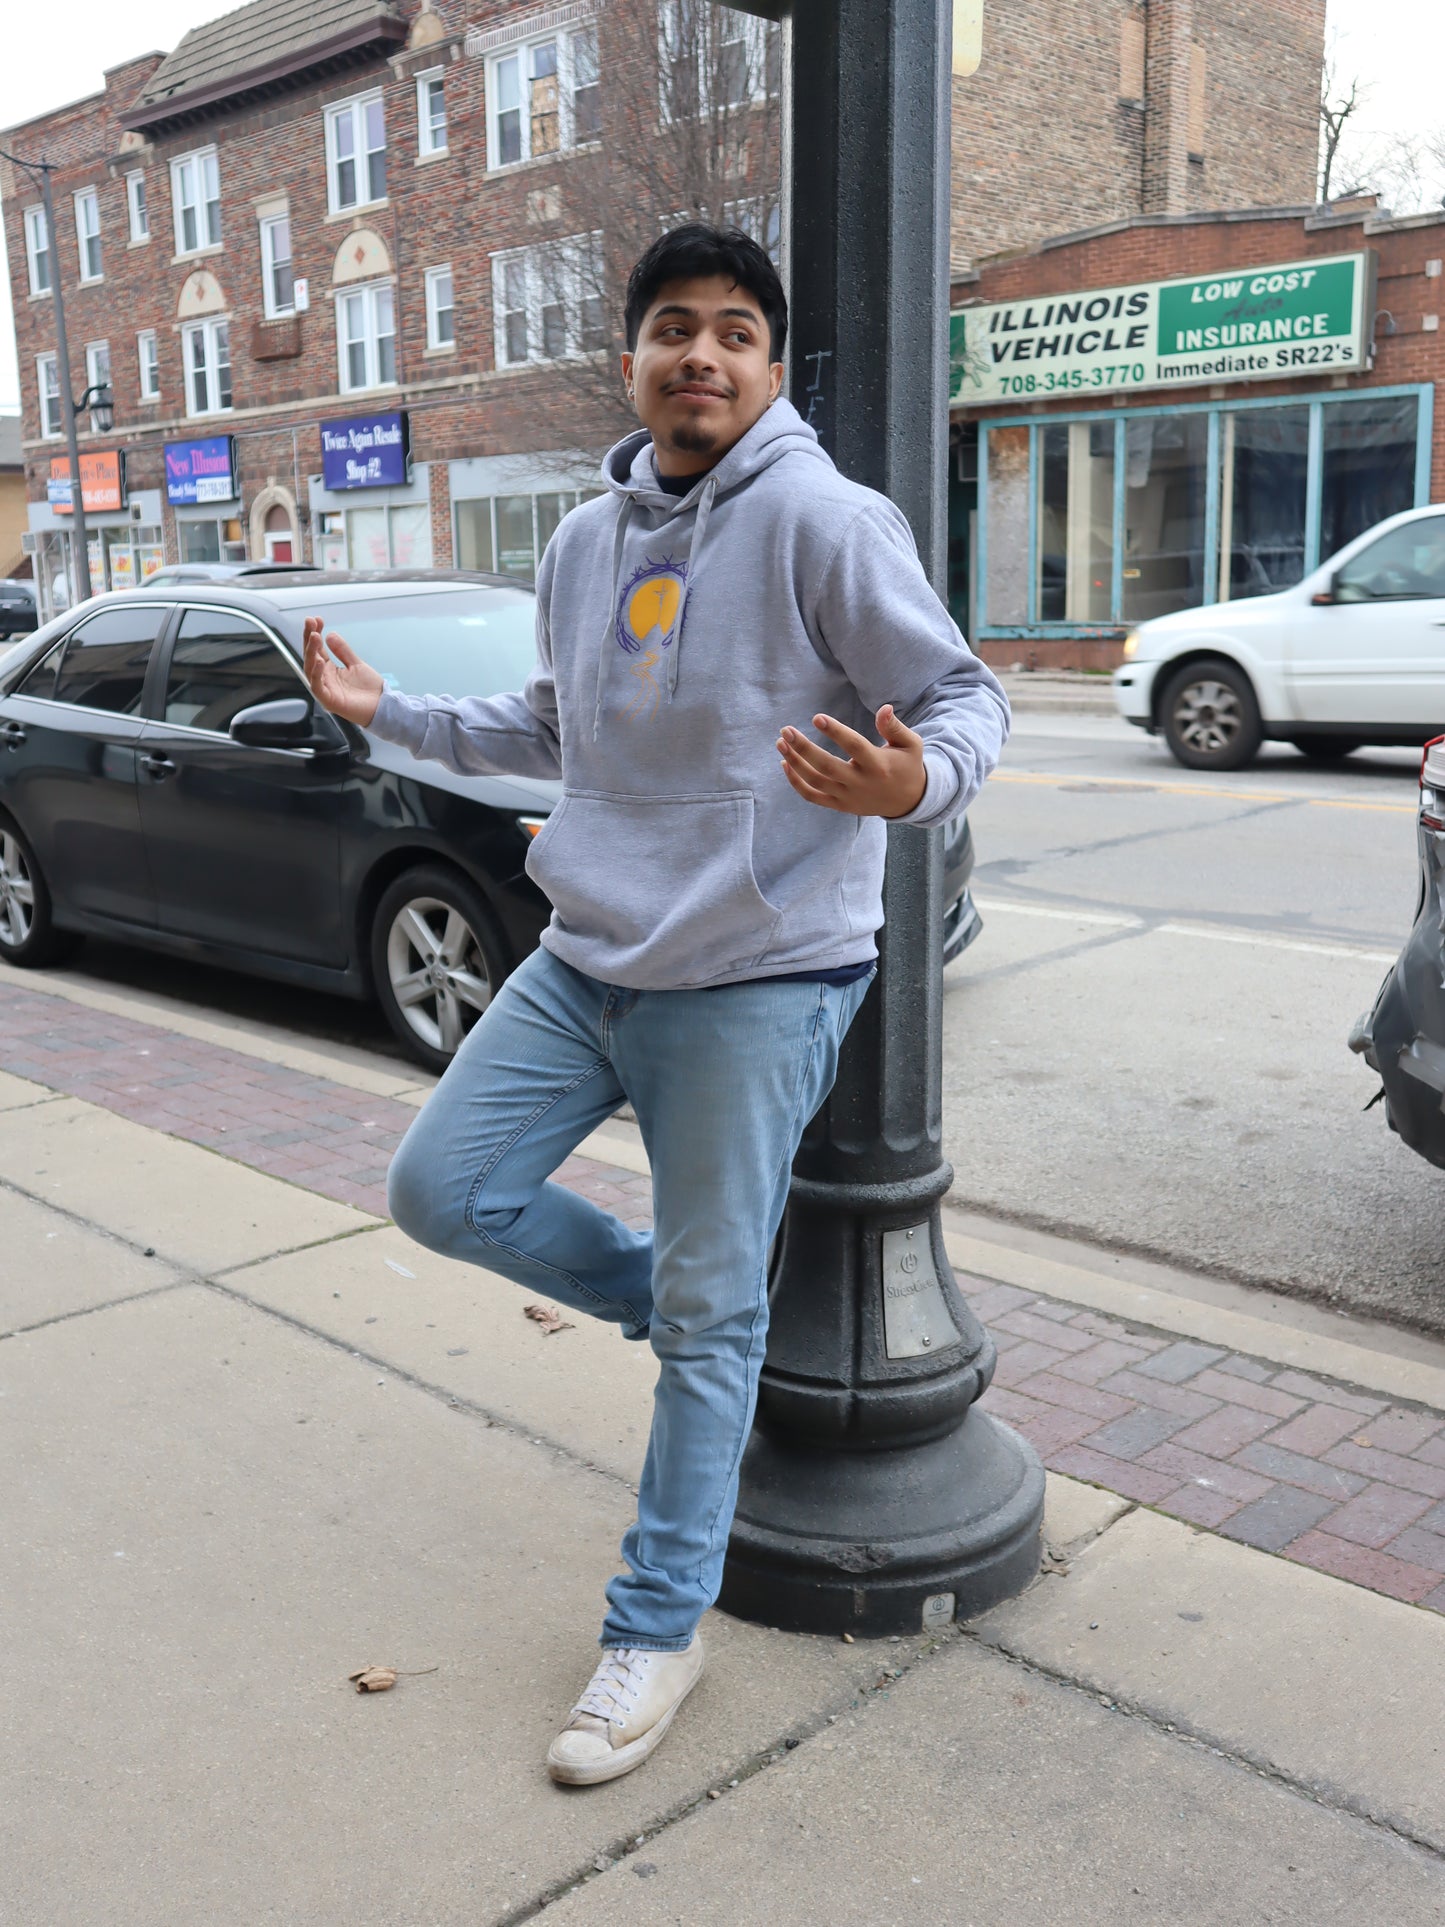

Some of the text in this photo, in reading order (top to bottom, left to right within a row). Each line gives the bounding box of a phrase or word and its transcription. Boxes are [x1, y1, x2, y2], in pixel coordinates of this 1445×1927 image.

[1191, 279, 1244, 304] LOW
[989, 291, 1150, 334] ILLINOIS
[1218, 297, 1284, 325] Auto
[990, 324, 1150, 363] VEHICLE
[1176, 312, 1330, 351] INSURANCE
[1156, 343, 1353, 379] Immediate SR22's
[1000, 362, 1145, 395] 708-345-3770
[321, 423, 402, 454] Twice Again Resale
[166, 447, 229, 479] New Illusion
[346, 456, 382, 484] Shop #2
